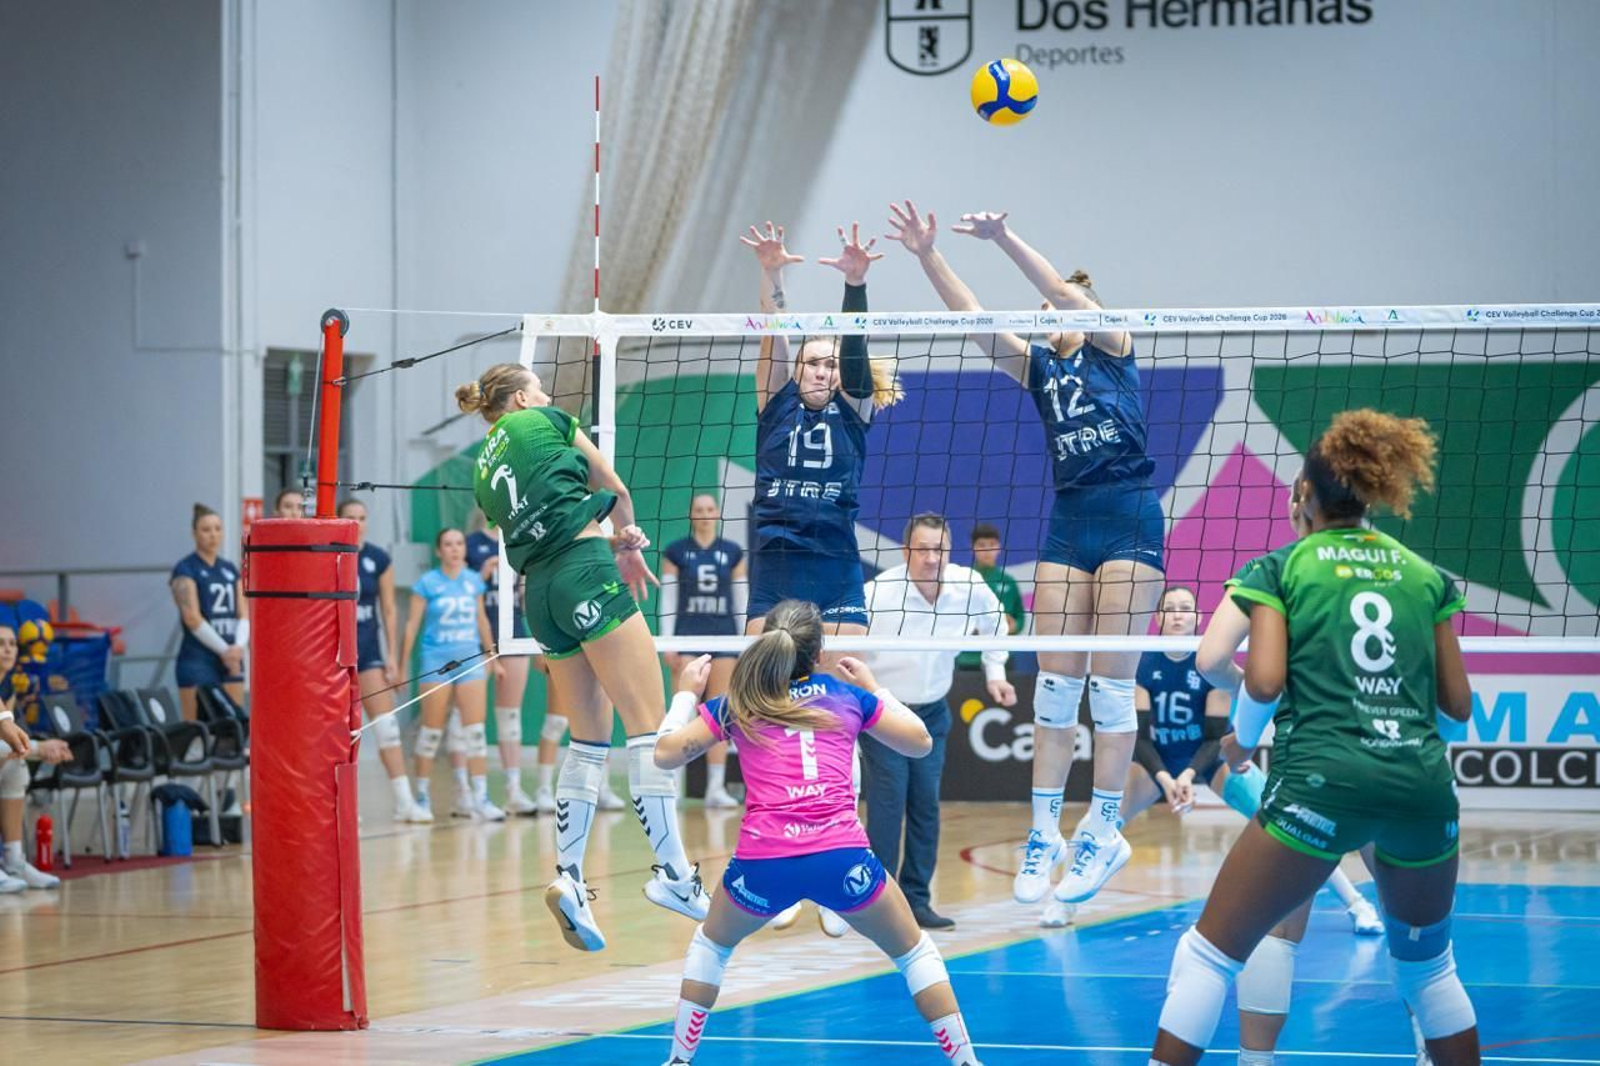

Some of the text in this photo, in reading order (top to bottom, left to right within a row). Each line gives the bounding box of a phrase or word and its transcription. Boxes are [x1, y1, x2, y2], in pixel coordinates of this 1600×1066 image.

[1017, 0, 1373, 31] Dos Hermanas
[1016, 43, 1125, 67] Deportes
[668, 319, 693, 330] CEV
[888, 317, 923, 327] Volleyball
[924, 317, 959, 327] Challenge
[960, 317, 975, 327] Cup
[1163, 315, 1178, 323] CEV
[1178, 314, 1214, 324] Volleyball
[1215, 313, 1251, 324] Challenge
[1253, 313, 1268, 323] Cup
[1486, 310, 1501, 318] CEV
[1503, 310, 1539, 320] Volleyball
[1540, 309, 1577, 319] Challenge
[1579, 309, 1594, 319] Cup
[1043, 374, 1096, 423] 12
[478, 427, 507, 470] KIRA
[787, 422, 834, 469] 19
[490, 464, 518, 512] 7
[1317, 546, 1407, 565] MAGUI F.
[697, 564, 717, 593] 6
[209, 583, 235, 613] 21
[436, 596, 476, 625] 25
[1349, 591, 1396, 673] 8
[1355, 676, 1403, 695] WAY
[1154, 691, 1193, 724] 16
[784, 728, 819, 780] 1
[1454, 750, 1600, 785] COLC
[785, 784, 827, 799] WAY
